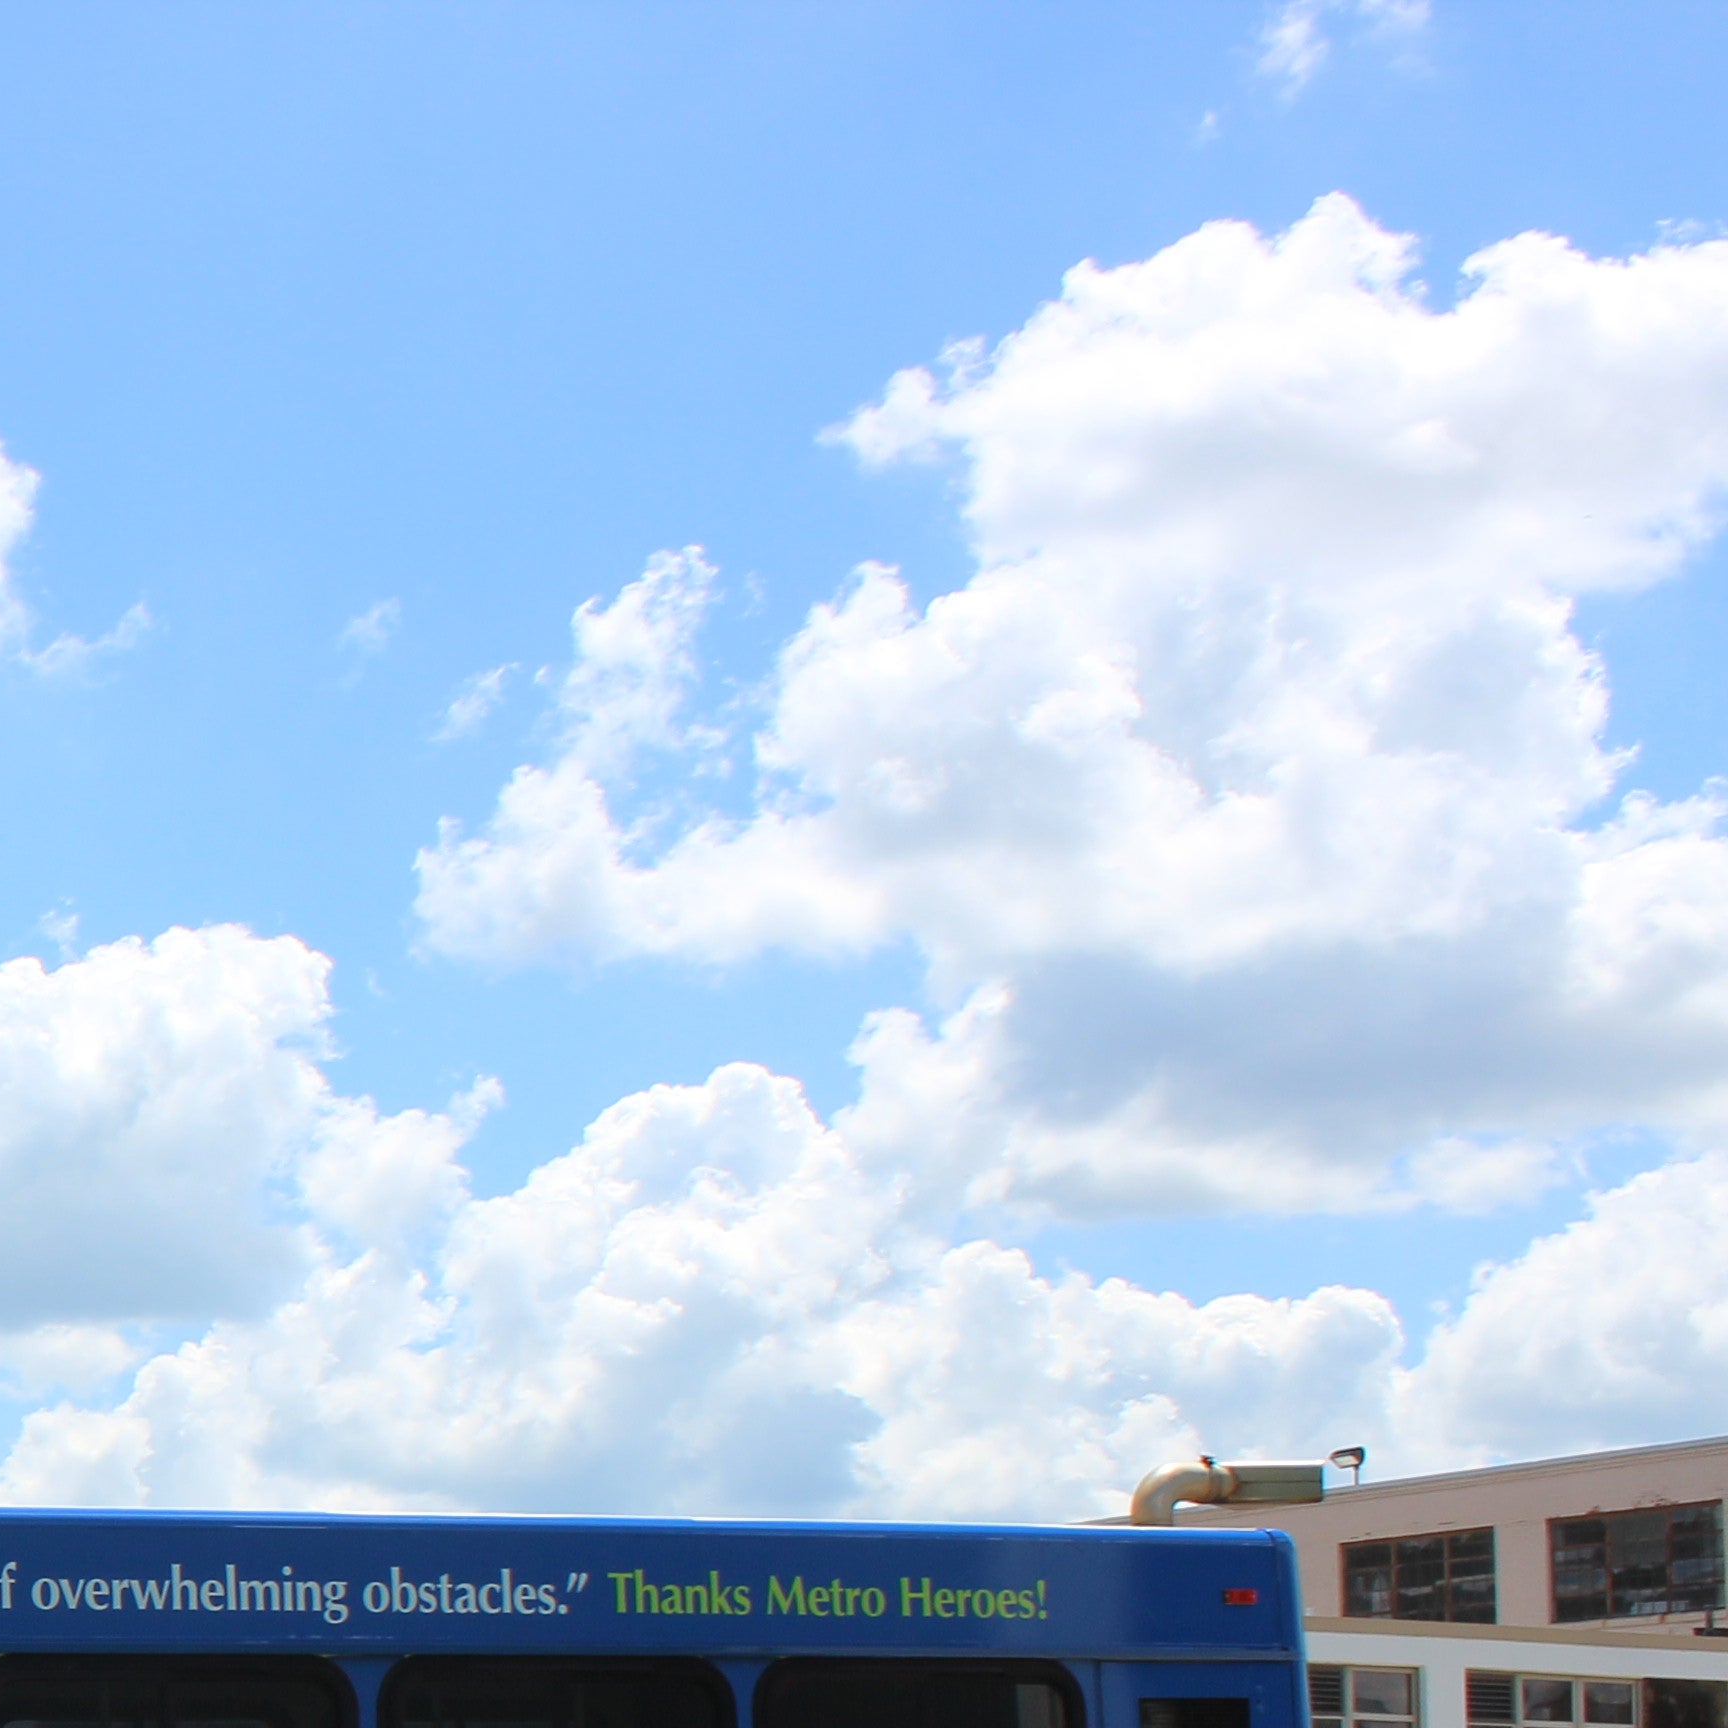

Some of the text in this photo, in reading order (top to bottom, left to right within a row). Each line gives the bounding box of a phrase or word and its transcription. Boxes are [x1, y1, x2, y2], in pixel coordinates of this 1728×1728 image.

[33, 1564, 348, 1623] overwhelming
[608, 1569, 1047, 1618] Thanks Metro Heroes!
